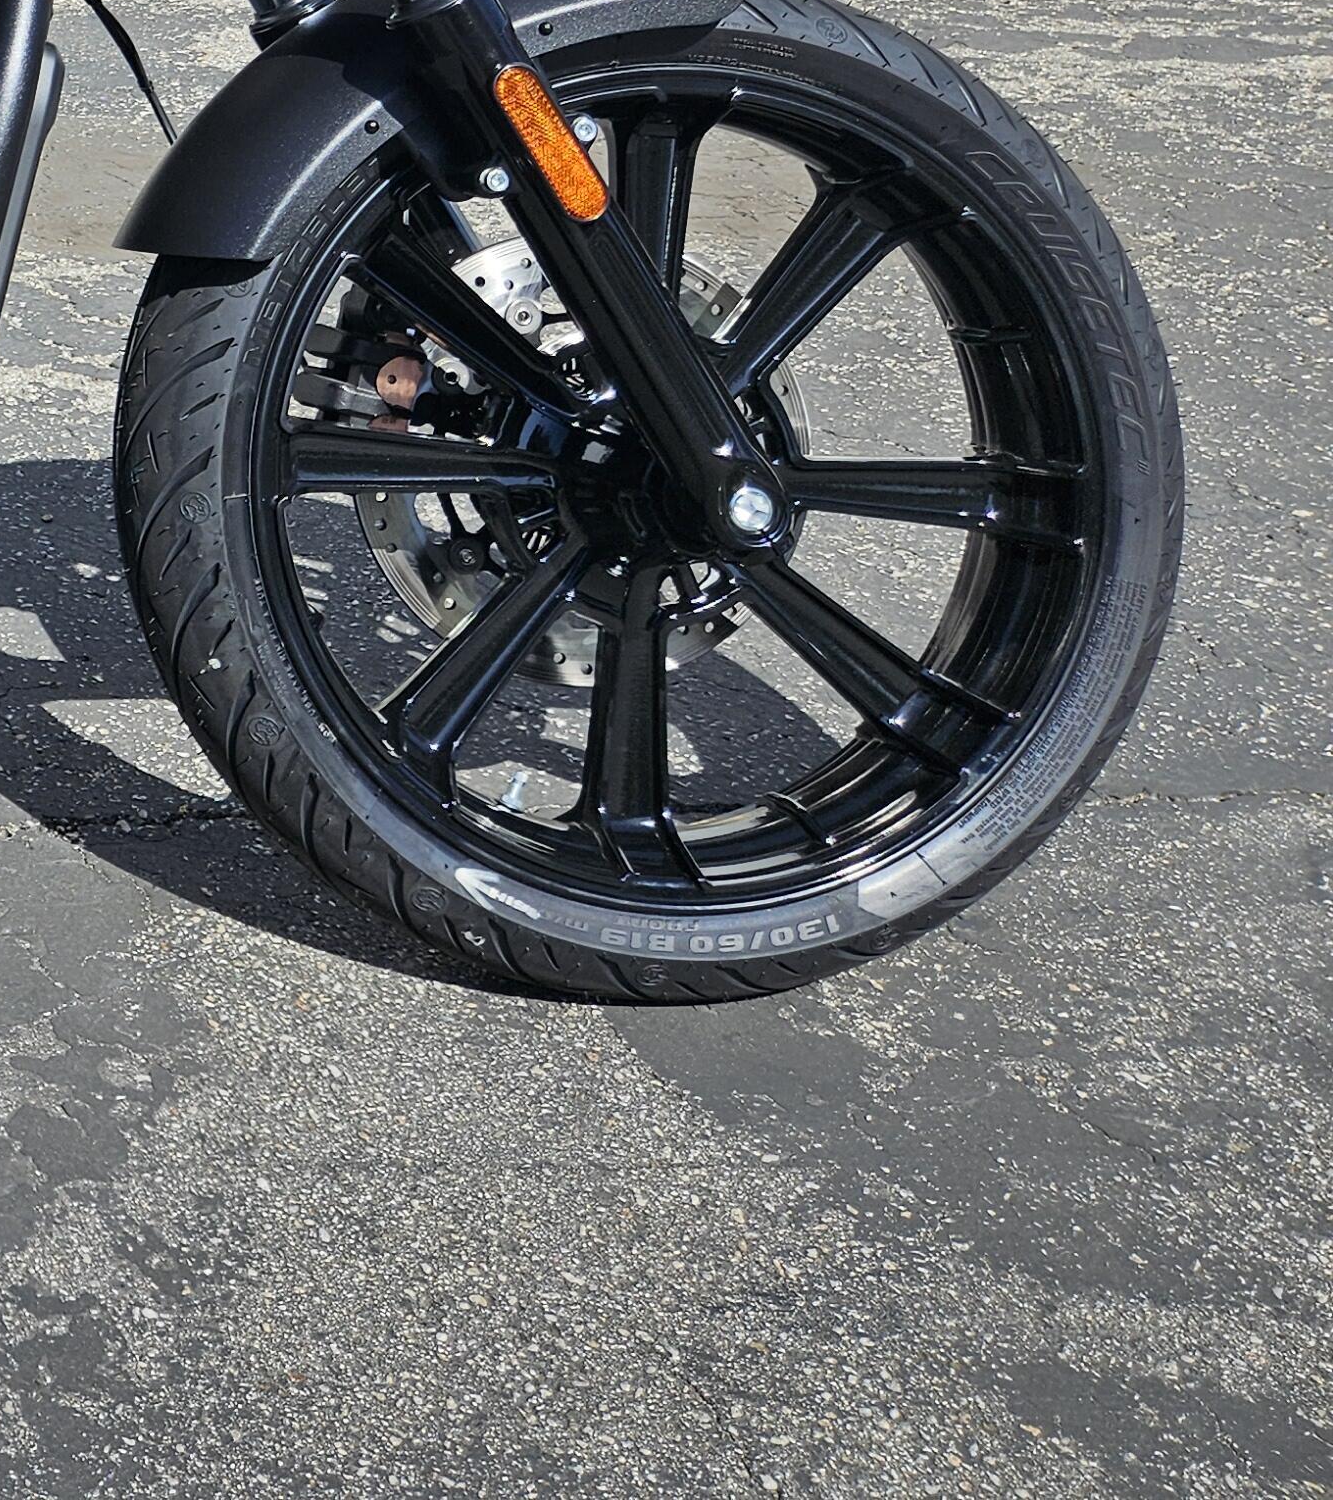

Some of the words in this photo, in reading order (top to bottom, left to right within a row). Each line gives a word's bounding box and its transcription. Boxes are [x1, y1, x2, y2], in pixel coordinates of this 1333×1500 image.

[964, 150, 1151, 462] CRUISETEC
[599, 927, 676, 953] B19
[689, 914, 841, 954] 130/60
